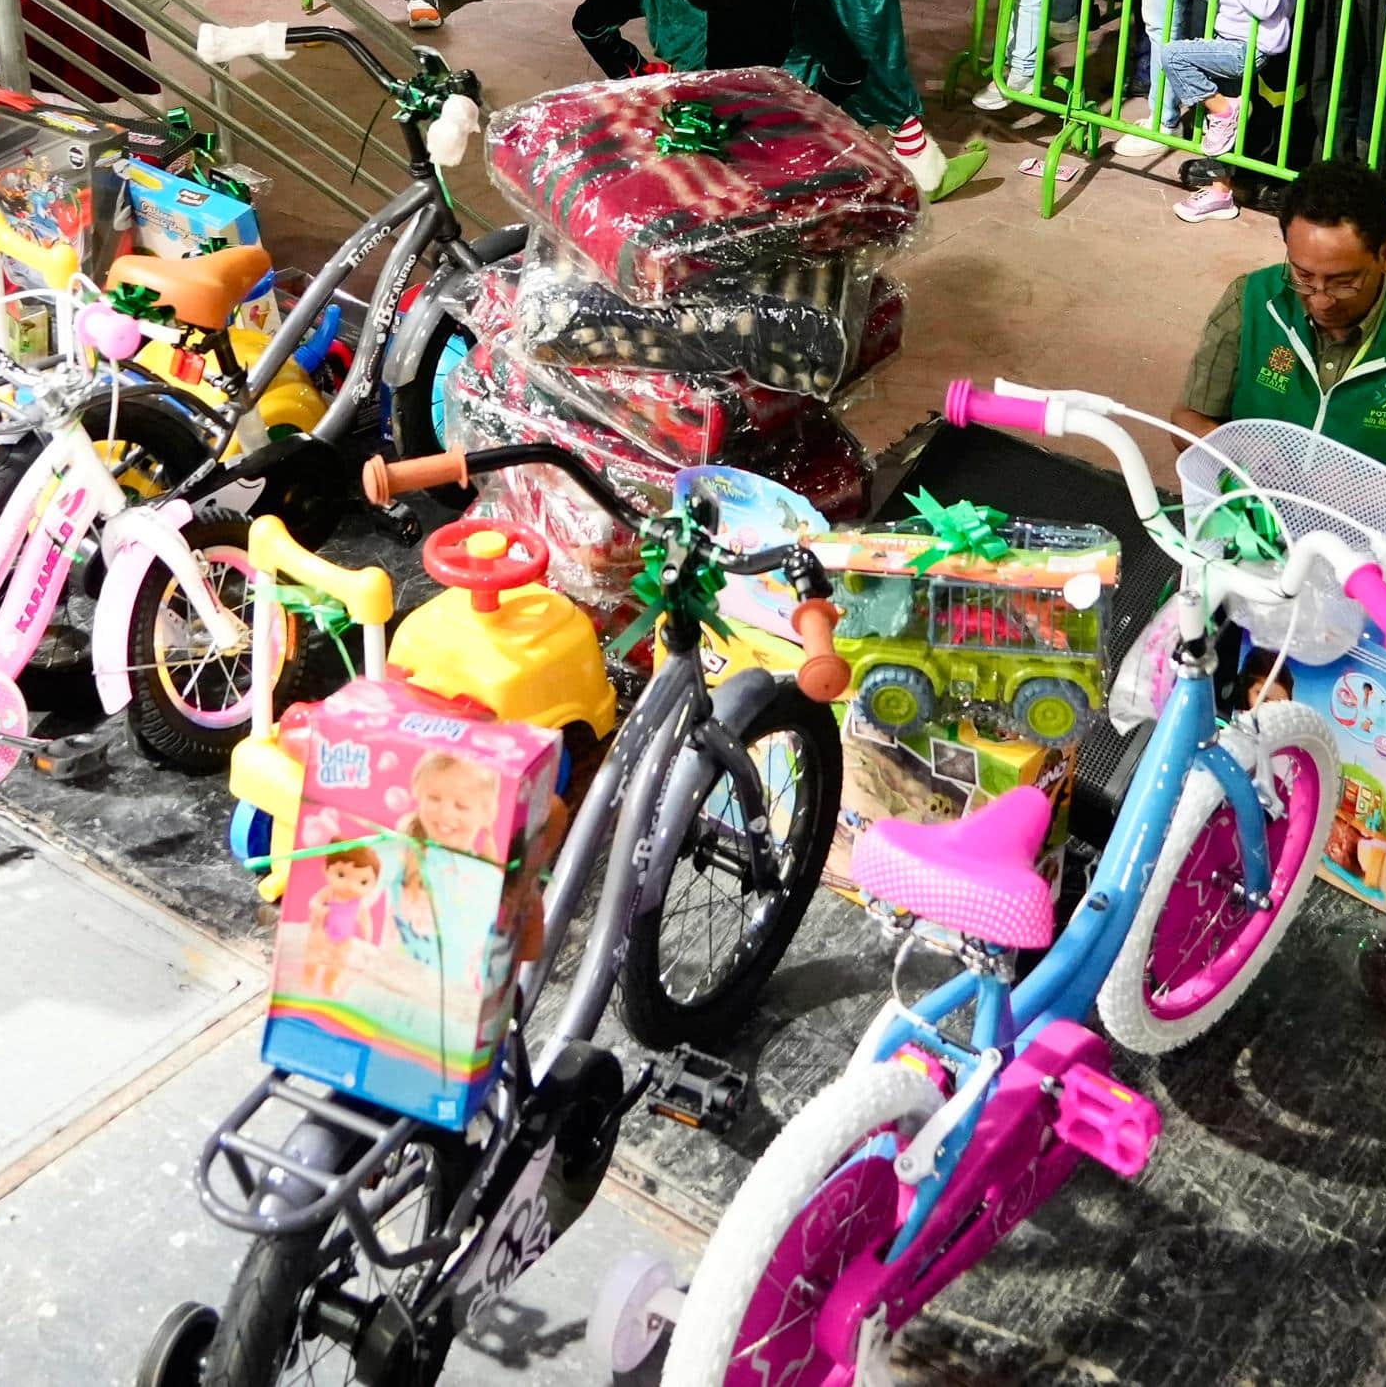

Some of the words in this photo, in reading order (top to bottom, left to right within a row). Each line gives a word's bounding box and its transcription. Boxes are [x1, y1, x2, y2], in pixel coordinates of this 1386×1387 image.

[339, 225, 392, 269] TURBO
[373, 254, 417, 328] BUCANERO
[320, 741, 367, 766] baby
[320, 763, 368, 784] alive
